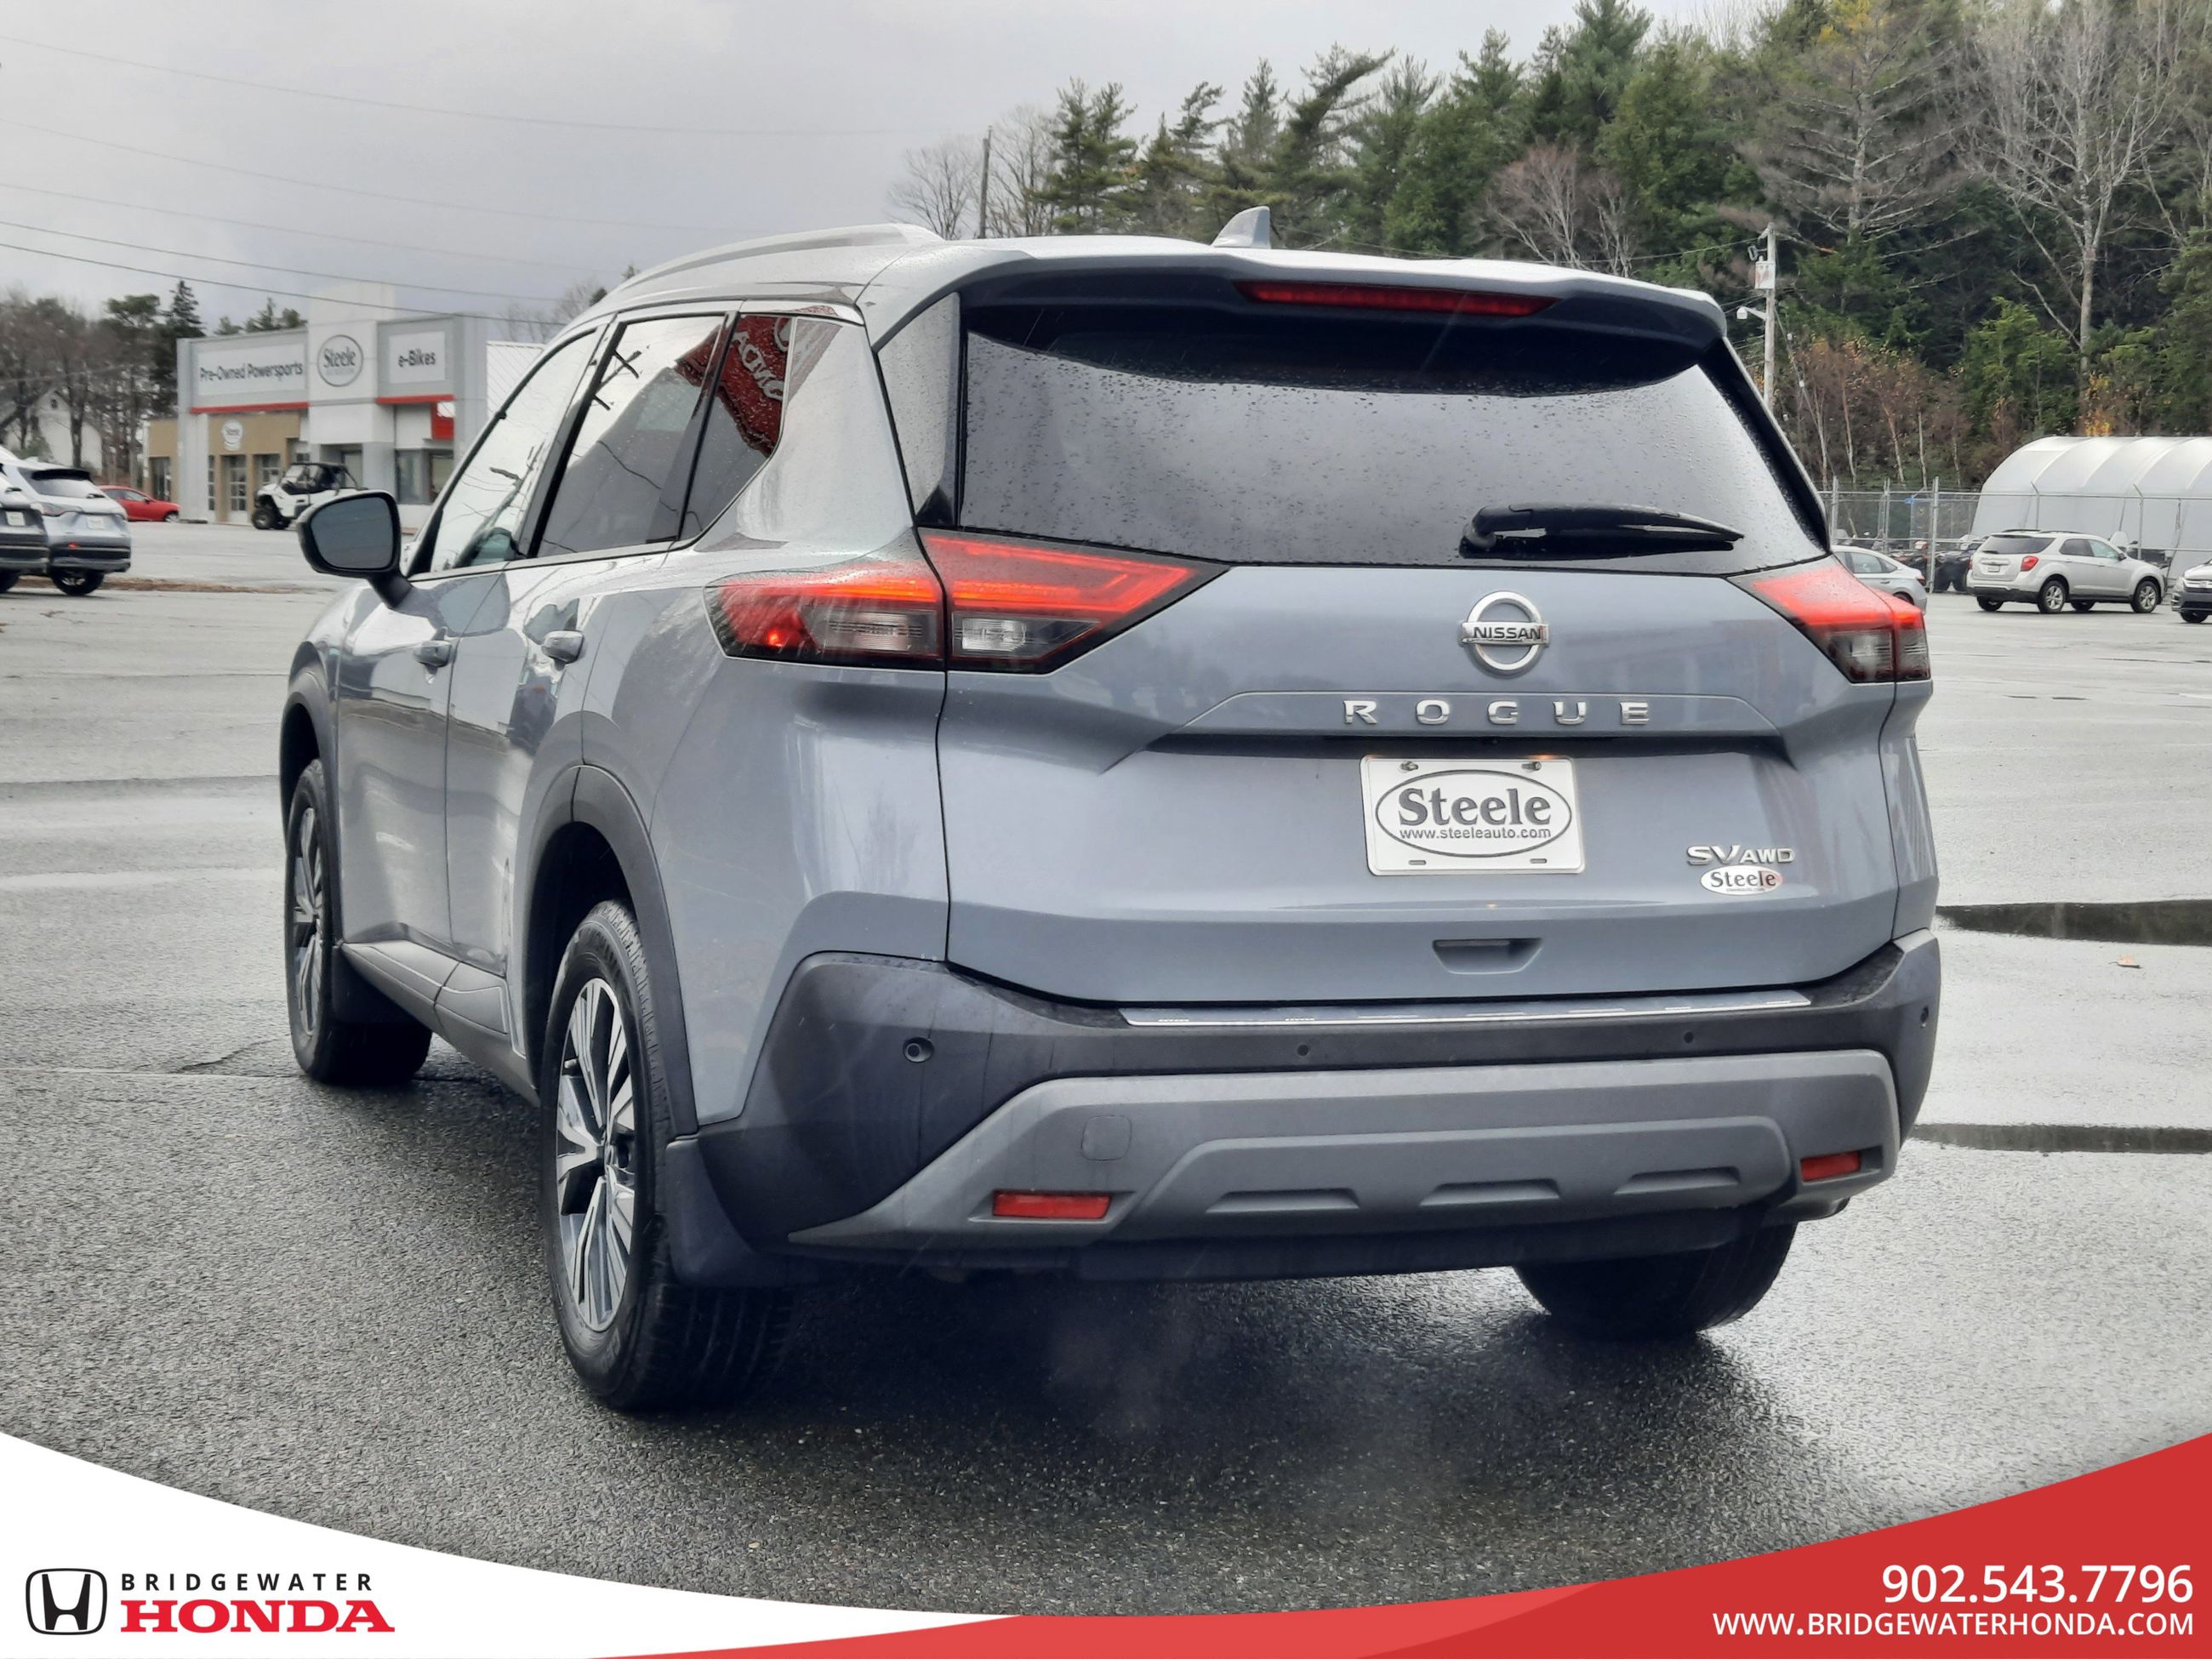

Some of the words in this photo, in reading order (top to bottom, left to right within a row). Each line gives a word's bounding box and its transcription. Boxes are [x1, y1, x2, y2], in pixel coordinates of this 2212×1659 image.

[323, 346, 356, 368] Steele
[398, 348, 436, 367] e-Bikes
[200, 363, 245, 381] Pre-Owned
[248, 361, 303, 381] Powersports
[1474, 626, 1542, 640] NISSAN
[1343, 699, 1650, 724] ROGUE
[1398, 787, 1551, 826] Steele
[1400, 827, 1551, 839] www.steeleauto.com
[1710, 870, 1776, 887] Steele
